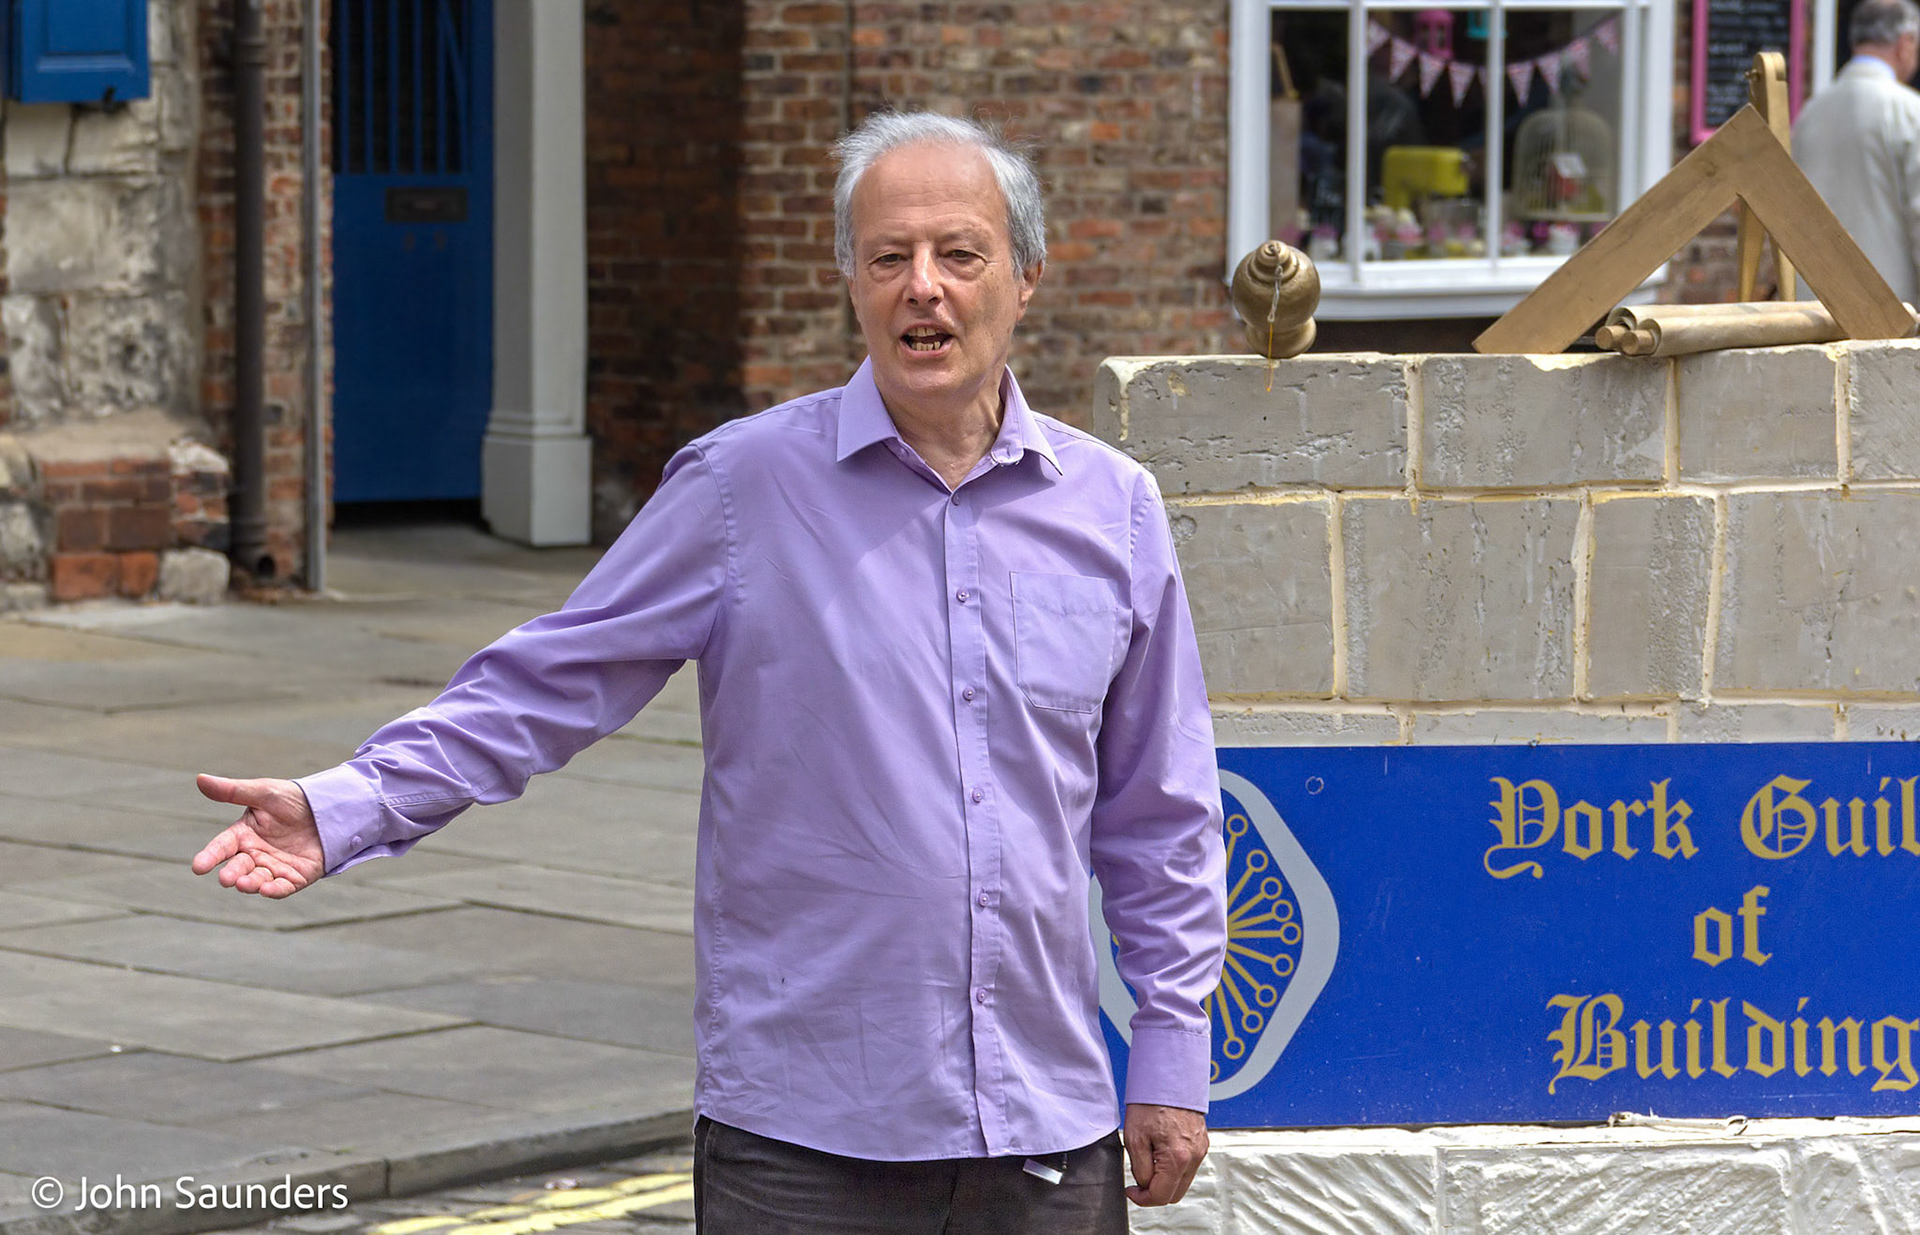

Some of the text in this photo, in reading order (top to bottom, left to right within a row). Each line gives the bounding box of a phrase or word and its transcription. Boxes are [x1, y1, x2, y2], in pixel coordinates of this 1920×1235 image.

[1483, 777, 1699, 879] York
[1692, 885, 1773, 967] of
[1546, 993, 1920, 1095] Building
